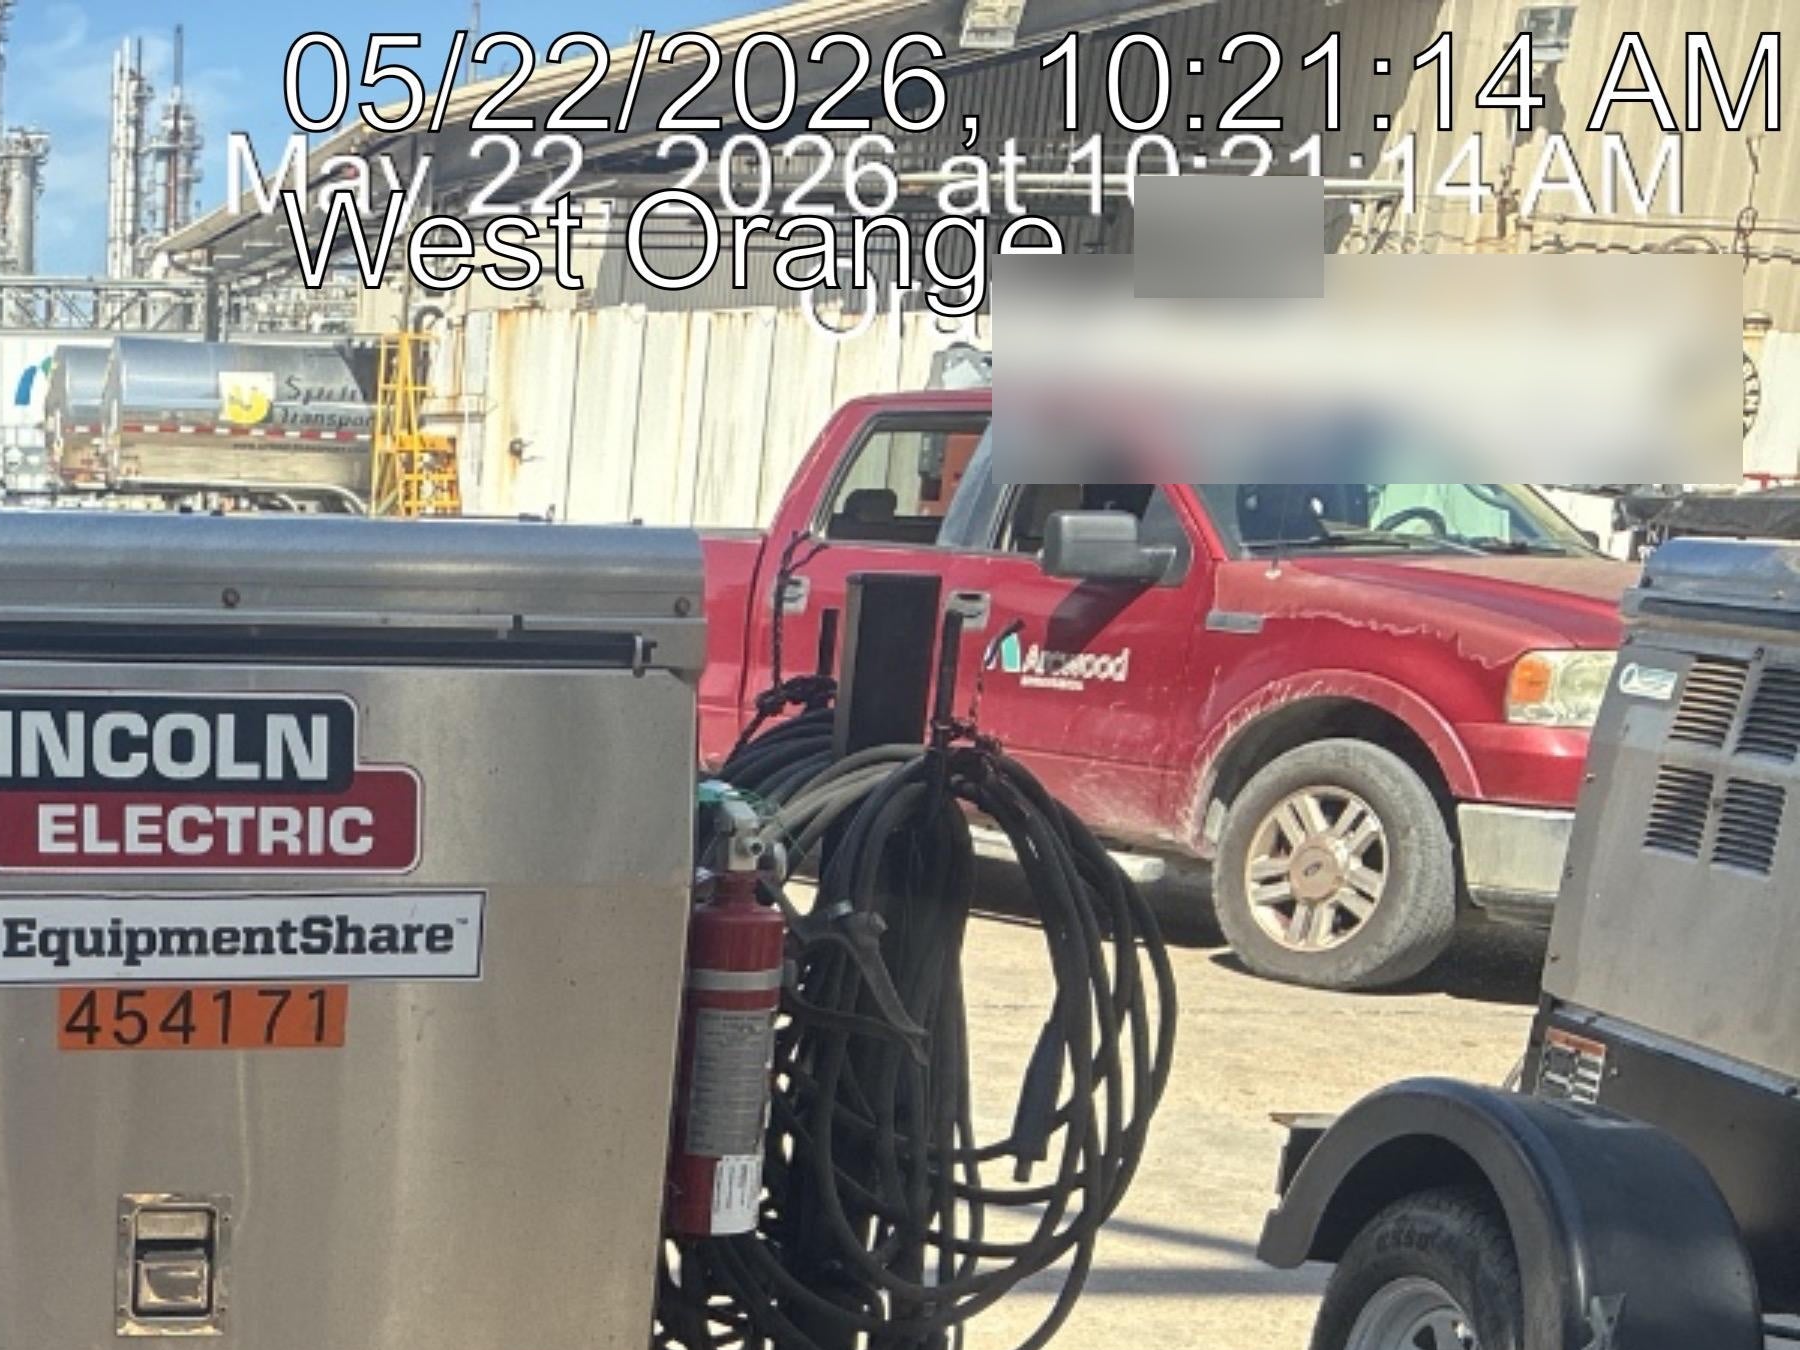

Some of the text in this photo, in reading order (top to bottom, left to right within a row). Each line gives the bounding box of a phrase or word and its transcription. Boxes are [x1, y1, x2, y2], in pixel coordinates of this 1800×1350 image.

[37, 803, 375, 856] ELECTRIC
[2, 916, 455, 967] EquipmentShare
[63, 988, 327, 1046] 454171
